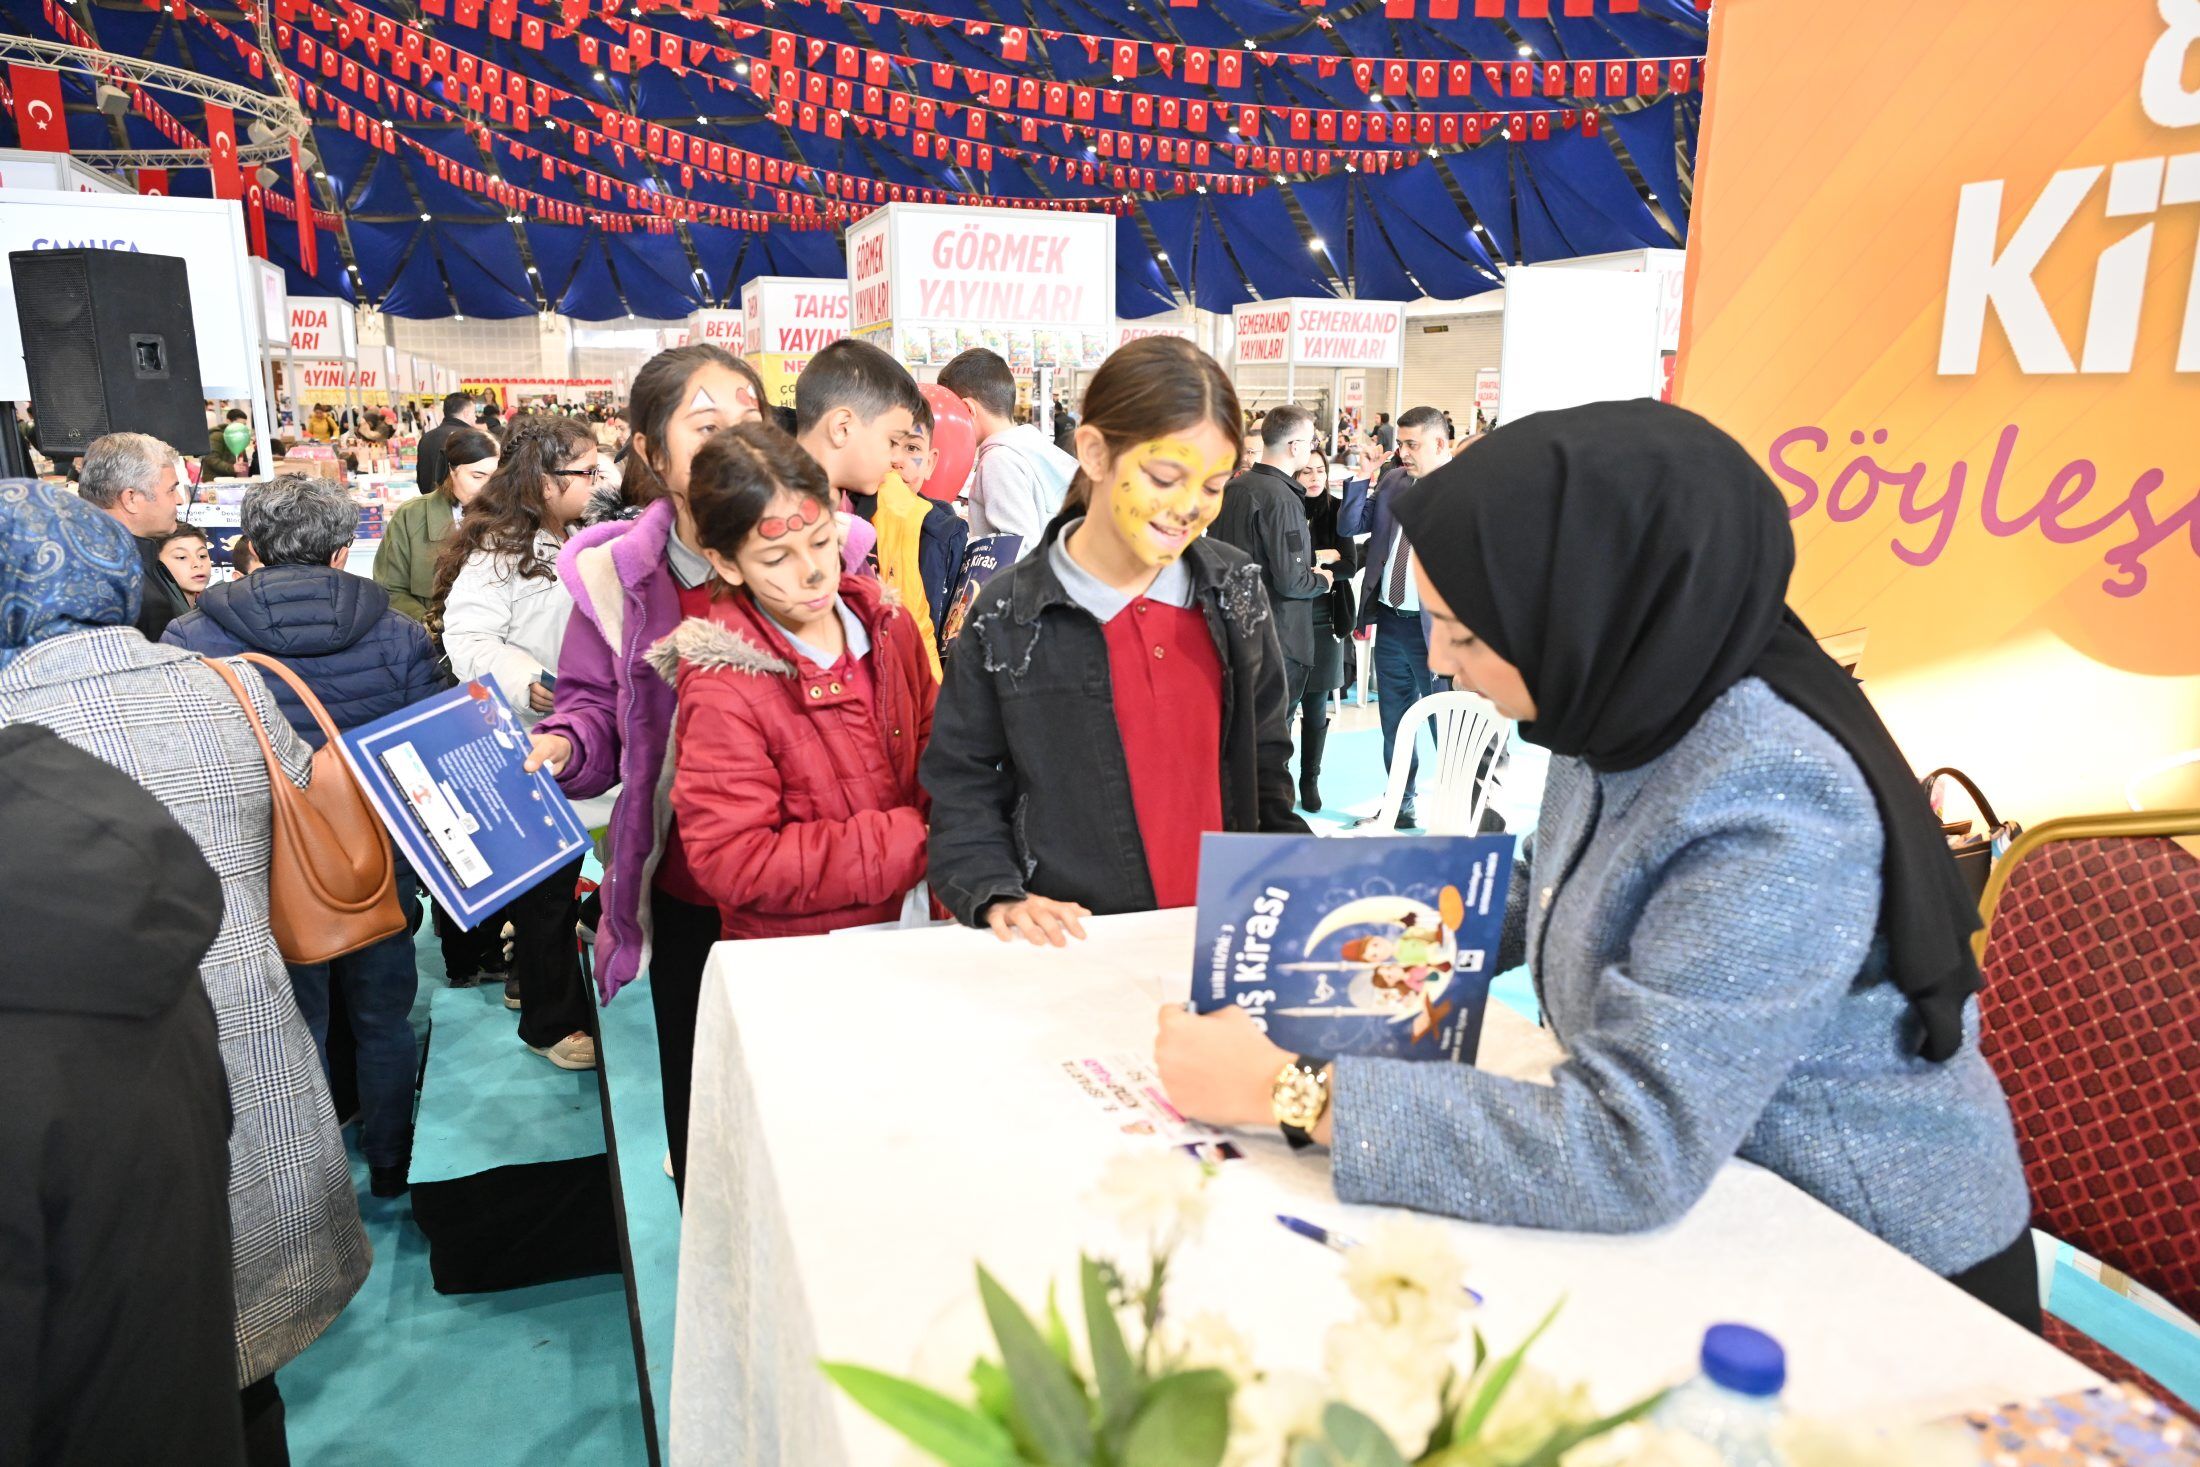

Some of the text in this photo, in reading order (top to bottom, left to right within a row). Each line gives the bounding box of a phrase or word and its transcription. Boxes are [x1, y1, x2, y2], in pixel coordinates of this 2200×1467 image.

[856, 233, 884, 282] GÖRMEK
[932, 223, 1070, 274] GÖRMEK
[855, 281, 889, 326] YAYINLARI
[919, 278, 1084, 322] YAYINLARI
[292, 310, 328, 328] NDA
[706, 320, 743, 338] BEYA
[1238, 311, 1290, 336] SEMERKAND
[1298, 310, 1398, 333] SEMERKAND
[291, 332, 319, 350] ARI
[779, 327, 848, 351] YAYIN
[1240, 338, 1284, 360] YAYINLARI
[1304, 337, 1386, 359] YAYINLARI
[1233, 886, 1290, 983] Kirası
